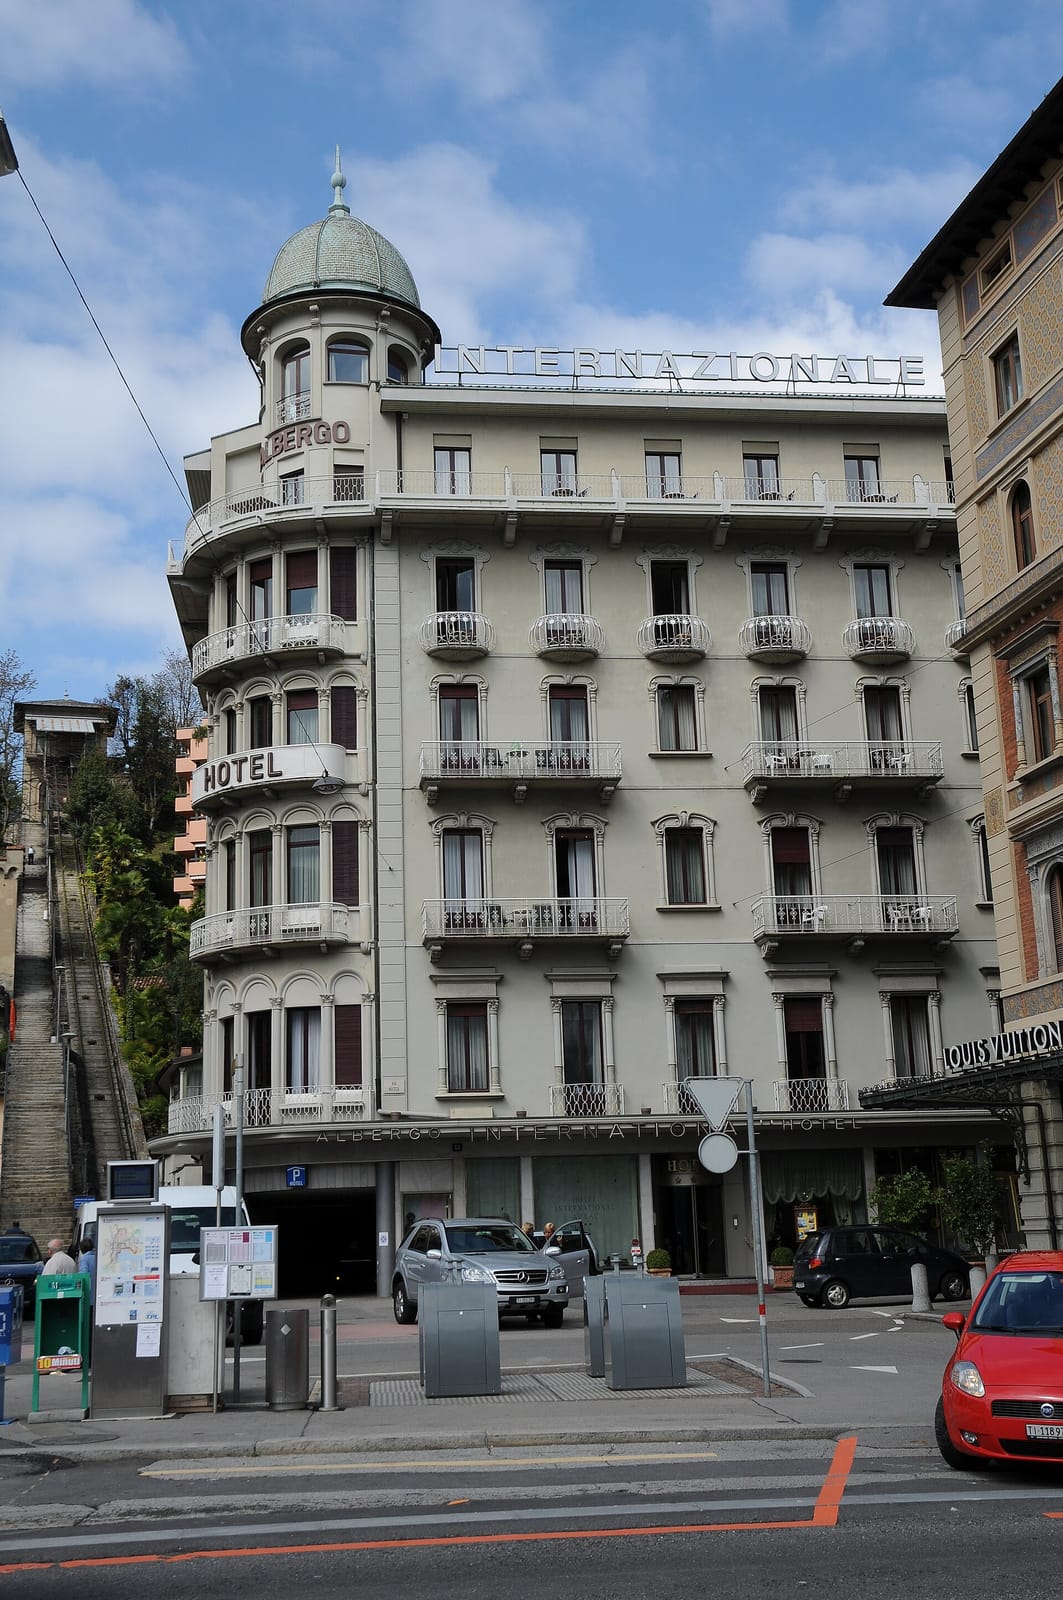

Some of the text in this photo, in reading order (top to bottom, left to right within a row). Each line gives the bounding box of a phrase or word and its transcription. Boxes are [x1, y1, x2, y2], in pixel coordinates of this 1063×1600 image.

[434, 343, 925, 385] INTERNAZIONALE
[204, 752, 282, 792] HOTEL
[943, 1021, 1063, 1069] LOUIS VUITTON
[316, 1127, 441, 1142] ALBERGO
[782, 1117, 862, 1131] HOTEL
[293, 1169, 300, 1181] P
